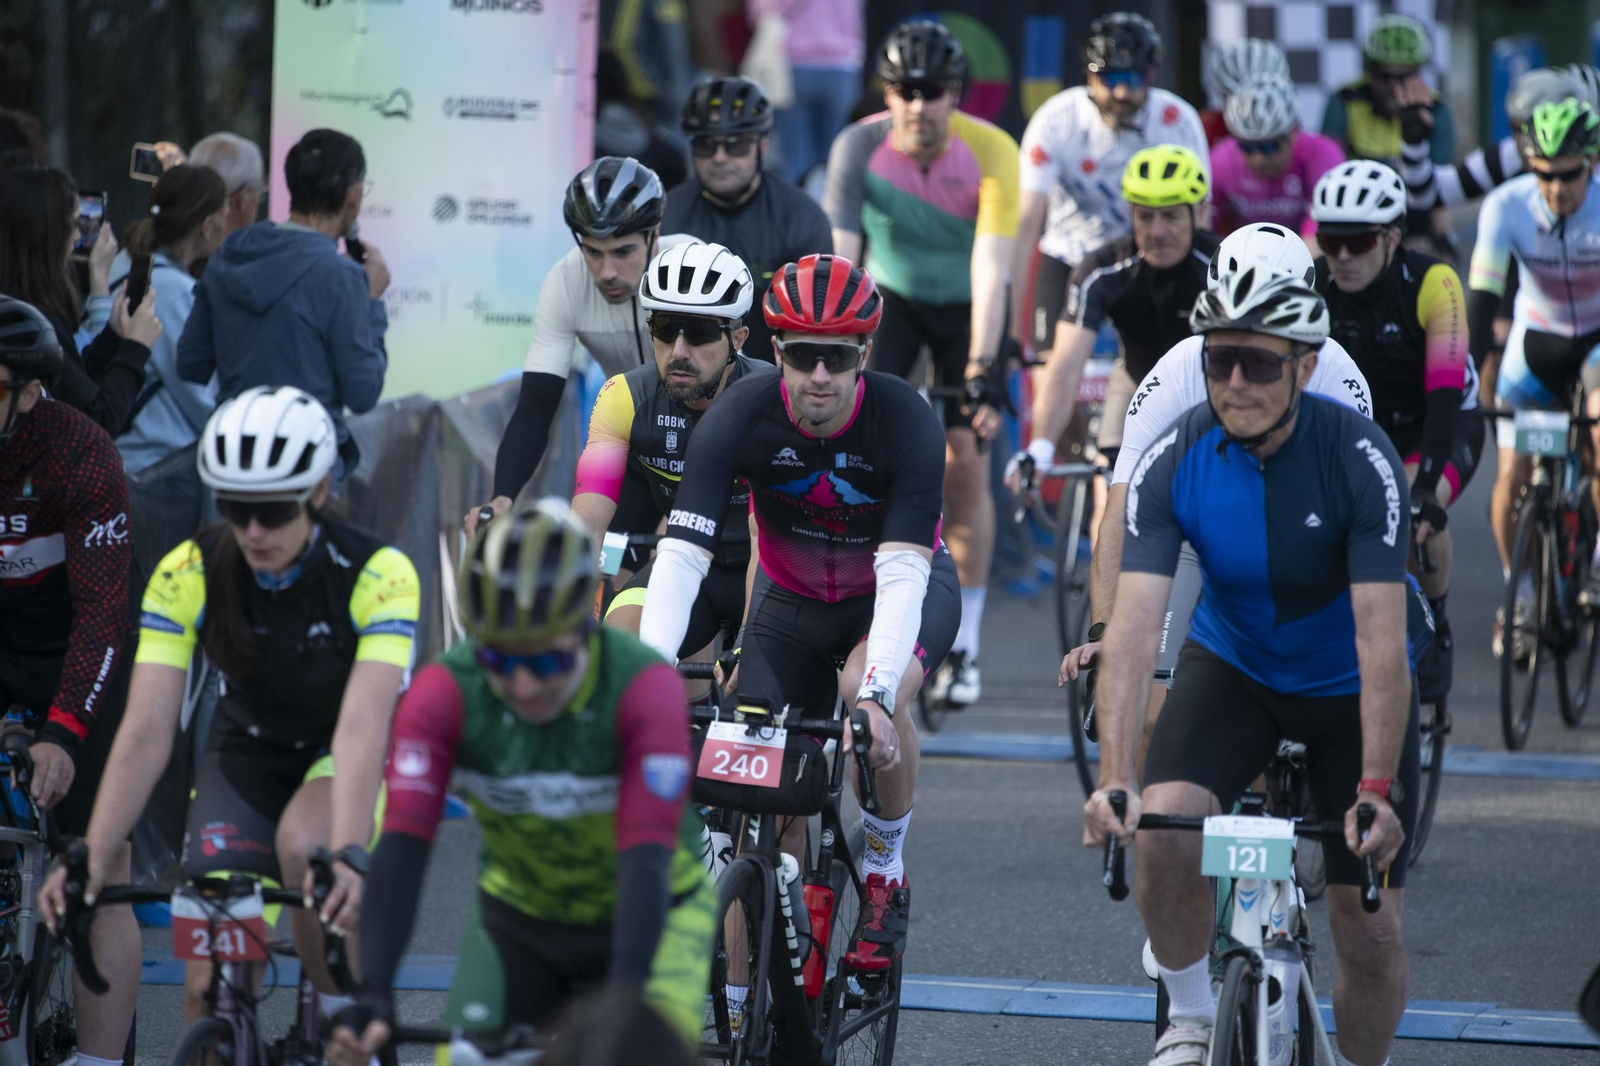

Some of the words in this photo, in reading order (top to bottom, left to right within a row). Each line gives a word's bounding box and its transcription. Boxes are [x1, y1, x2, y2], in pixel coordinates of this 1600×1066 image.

[1128, 376, 1161, 415] VAN
[657, 414, 686, 429] GOBIK
[1356, 437, 1401, 547] MERIDA
[1162, 611, 1174, 630] VAN
[712, 749, 769, 780] 240
[1227, 845, 1268, 873] 121
[191, 928, 246, 956] 241
